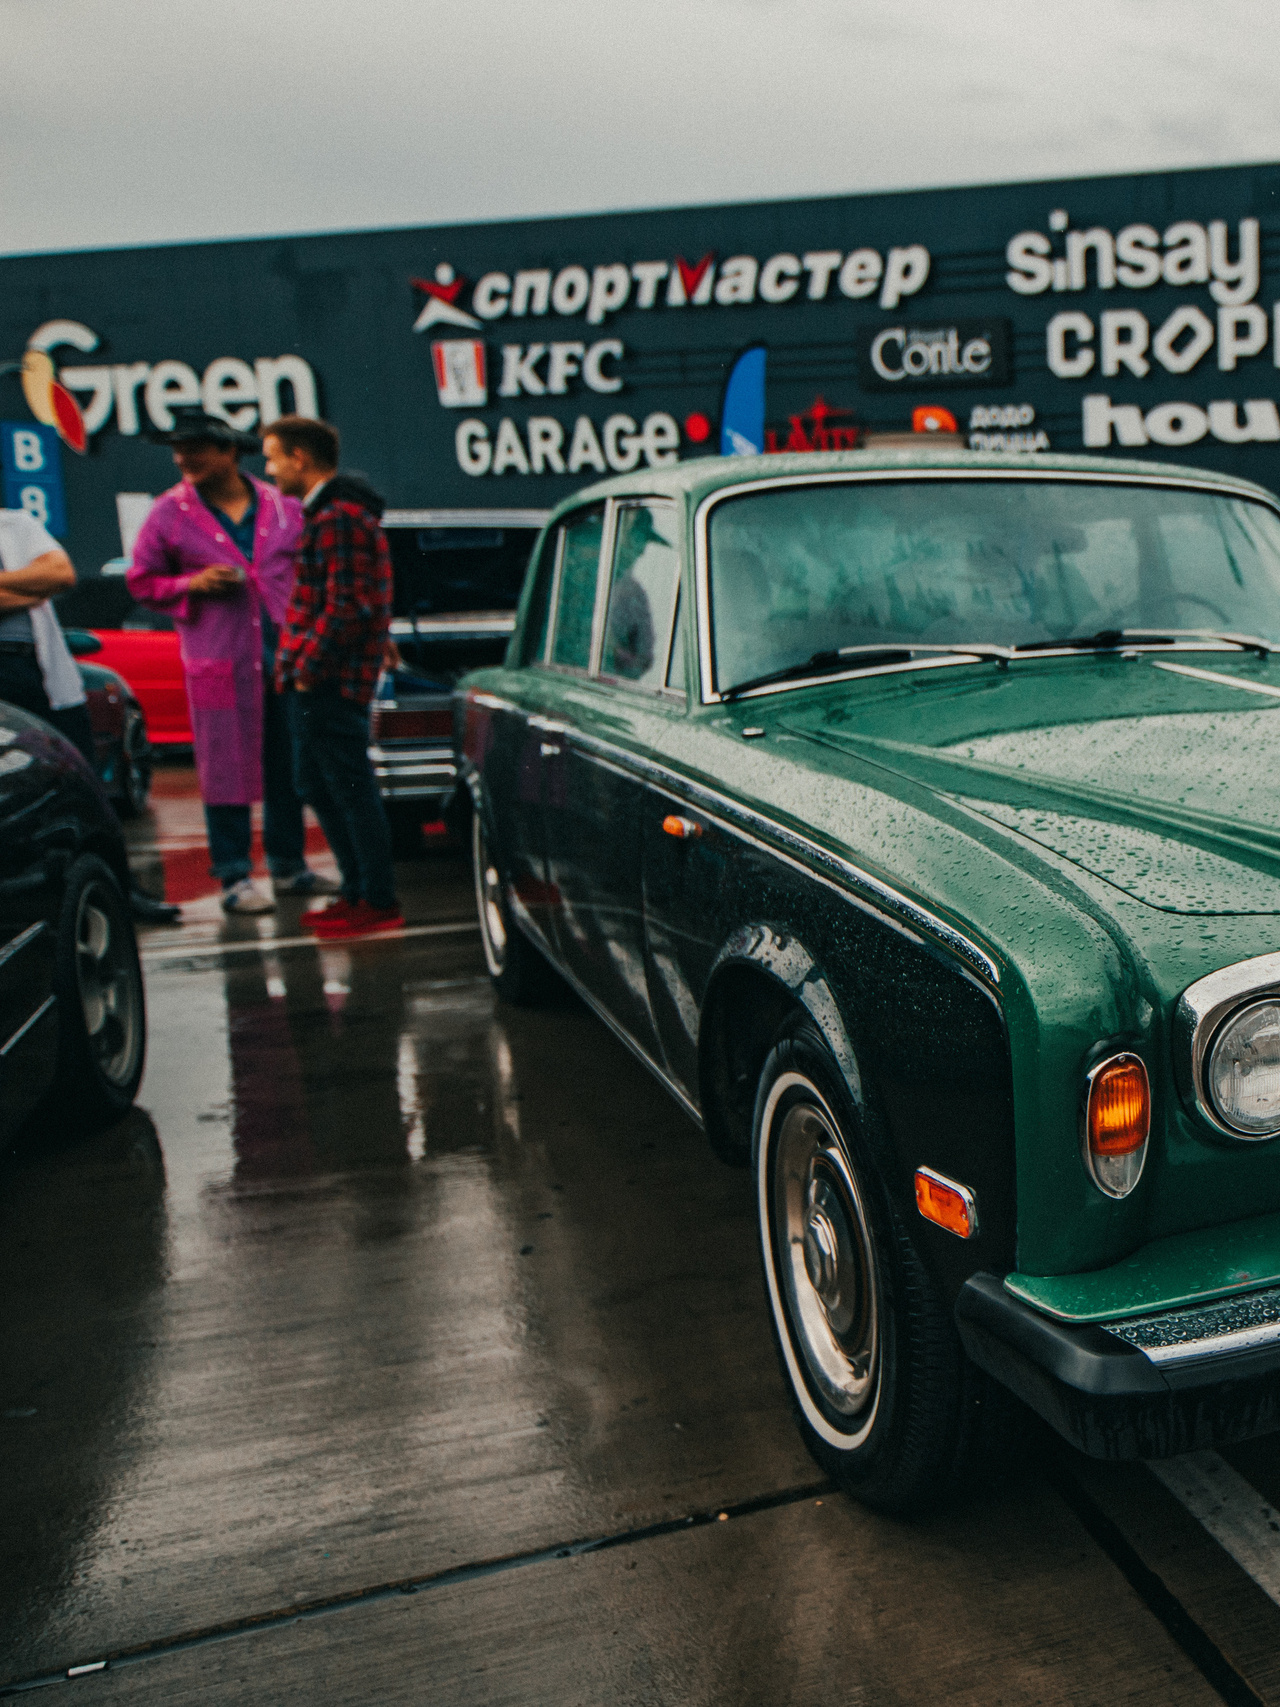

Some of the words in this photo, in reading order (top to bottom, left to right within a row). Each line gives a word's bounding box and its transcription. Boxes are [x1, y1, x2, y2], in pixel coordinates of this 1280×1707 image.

[471, 244, 931, 324] спортмастер
[1005, 208, 1261, 305] sinsay
[22, 319, 319, 437] Green
[498, 339, 624, 397] KFC
[871, 327, 992, 381] Conte
[455, 411, 680, 476] GARAGe
